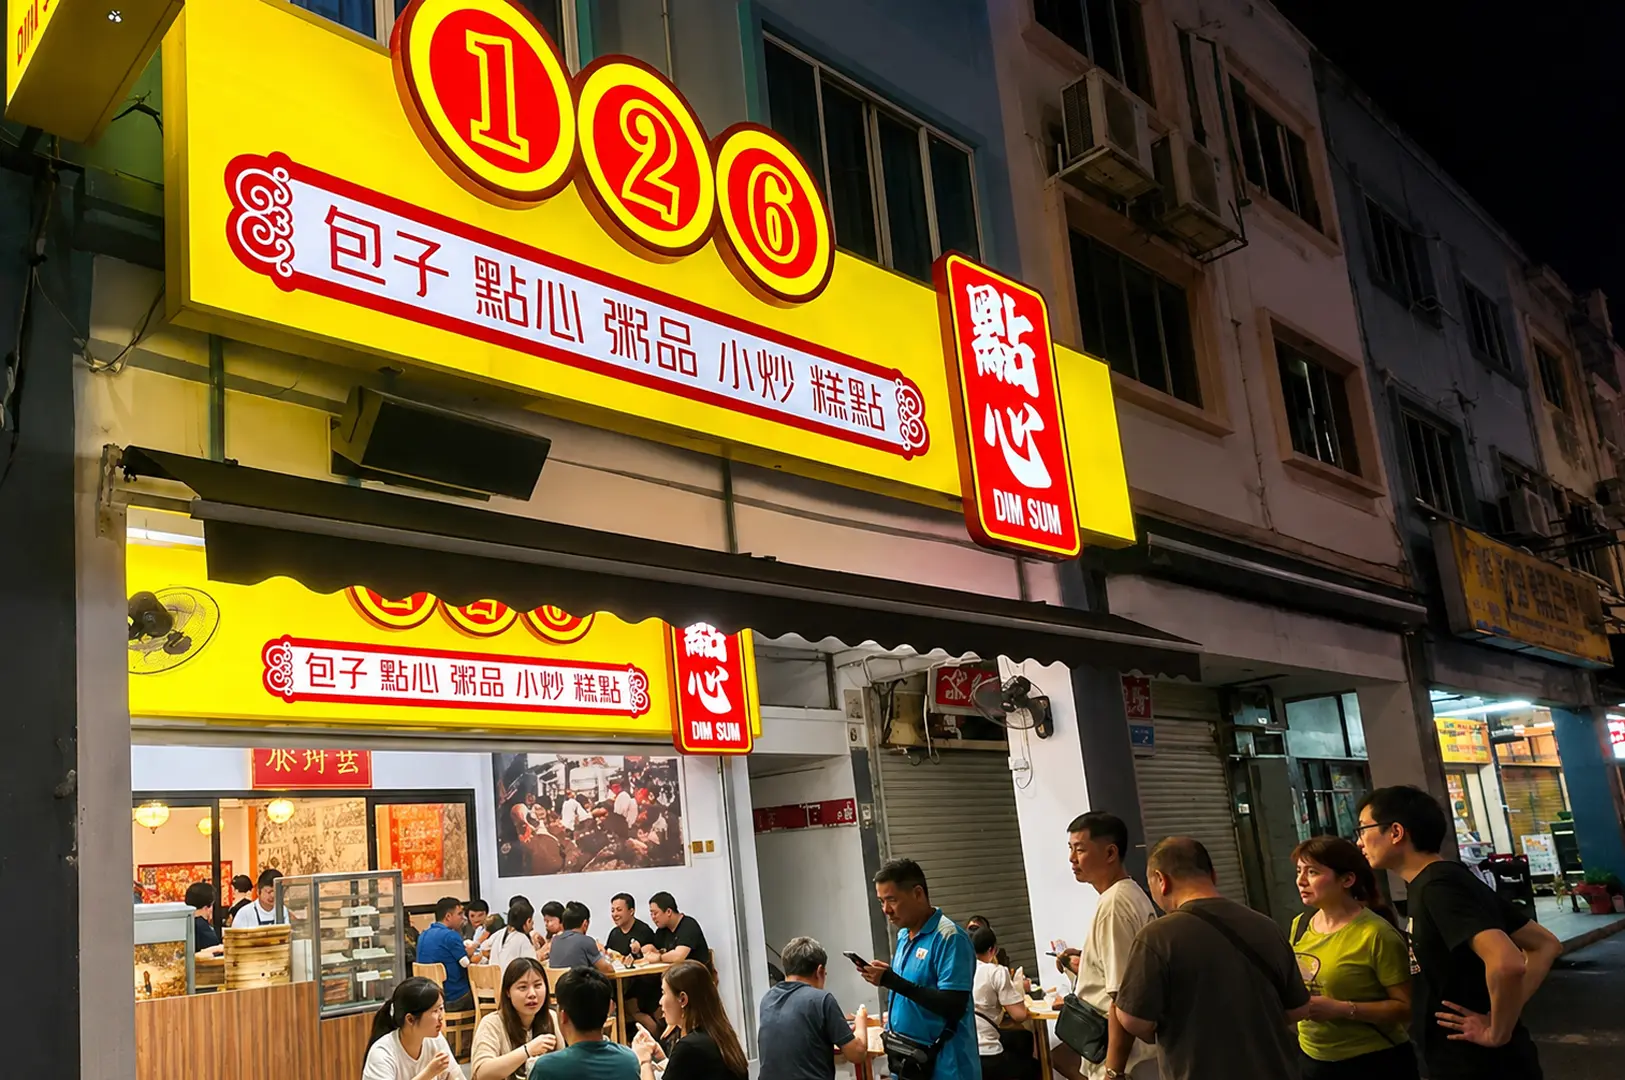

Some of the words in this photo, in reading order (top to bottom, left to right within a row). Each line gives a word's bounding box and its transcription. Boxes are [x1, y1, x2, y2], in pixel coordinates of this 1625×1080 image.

[324, 204, 450, 298] 包子
[474, 255, 585, 344] 點心
[603, 297, 698, 378] 粥品
[718, 338, 795, 404] 小炒
[809, 365, 886, 432] 糕點
[993, 488, 1025, 527] DIM
[1027, 497, 1063, 536] SUM
[306, 652, 368, 690] 包子
[380, 659, 438, 696] 點心
[450, 665, 505, 699] 粥品
[516, 669, 564, 703] 小炒
[574, 672, 621, 706] 糕點
[691, 720, 713, 741] DIM
[715, 721, 741, 742] SUM
